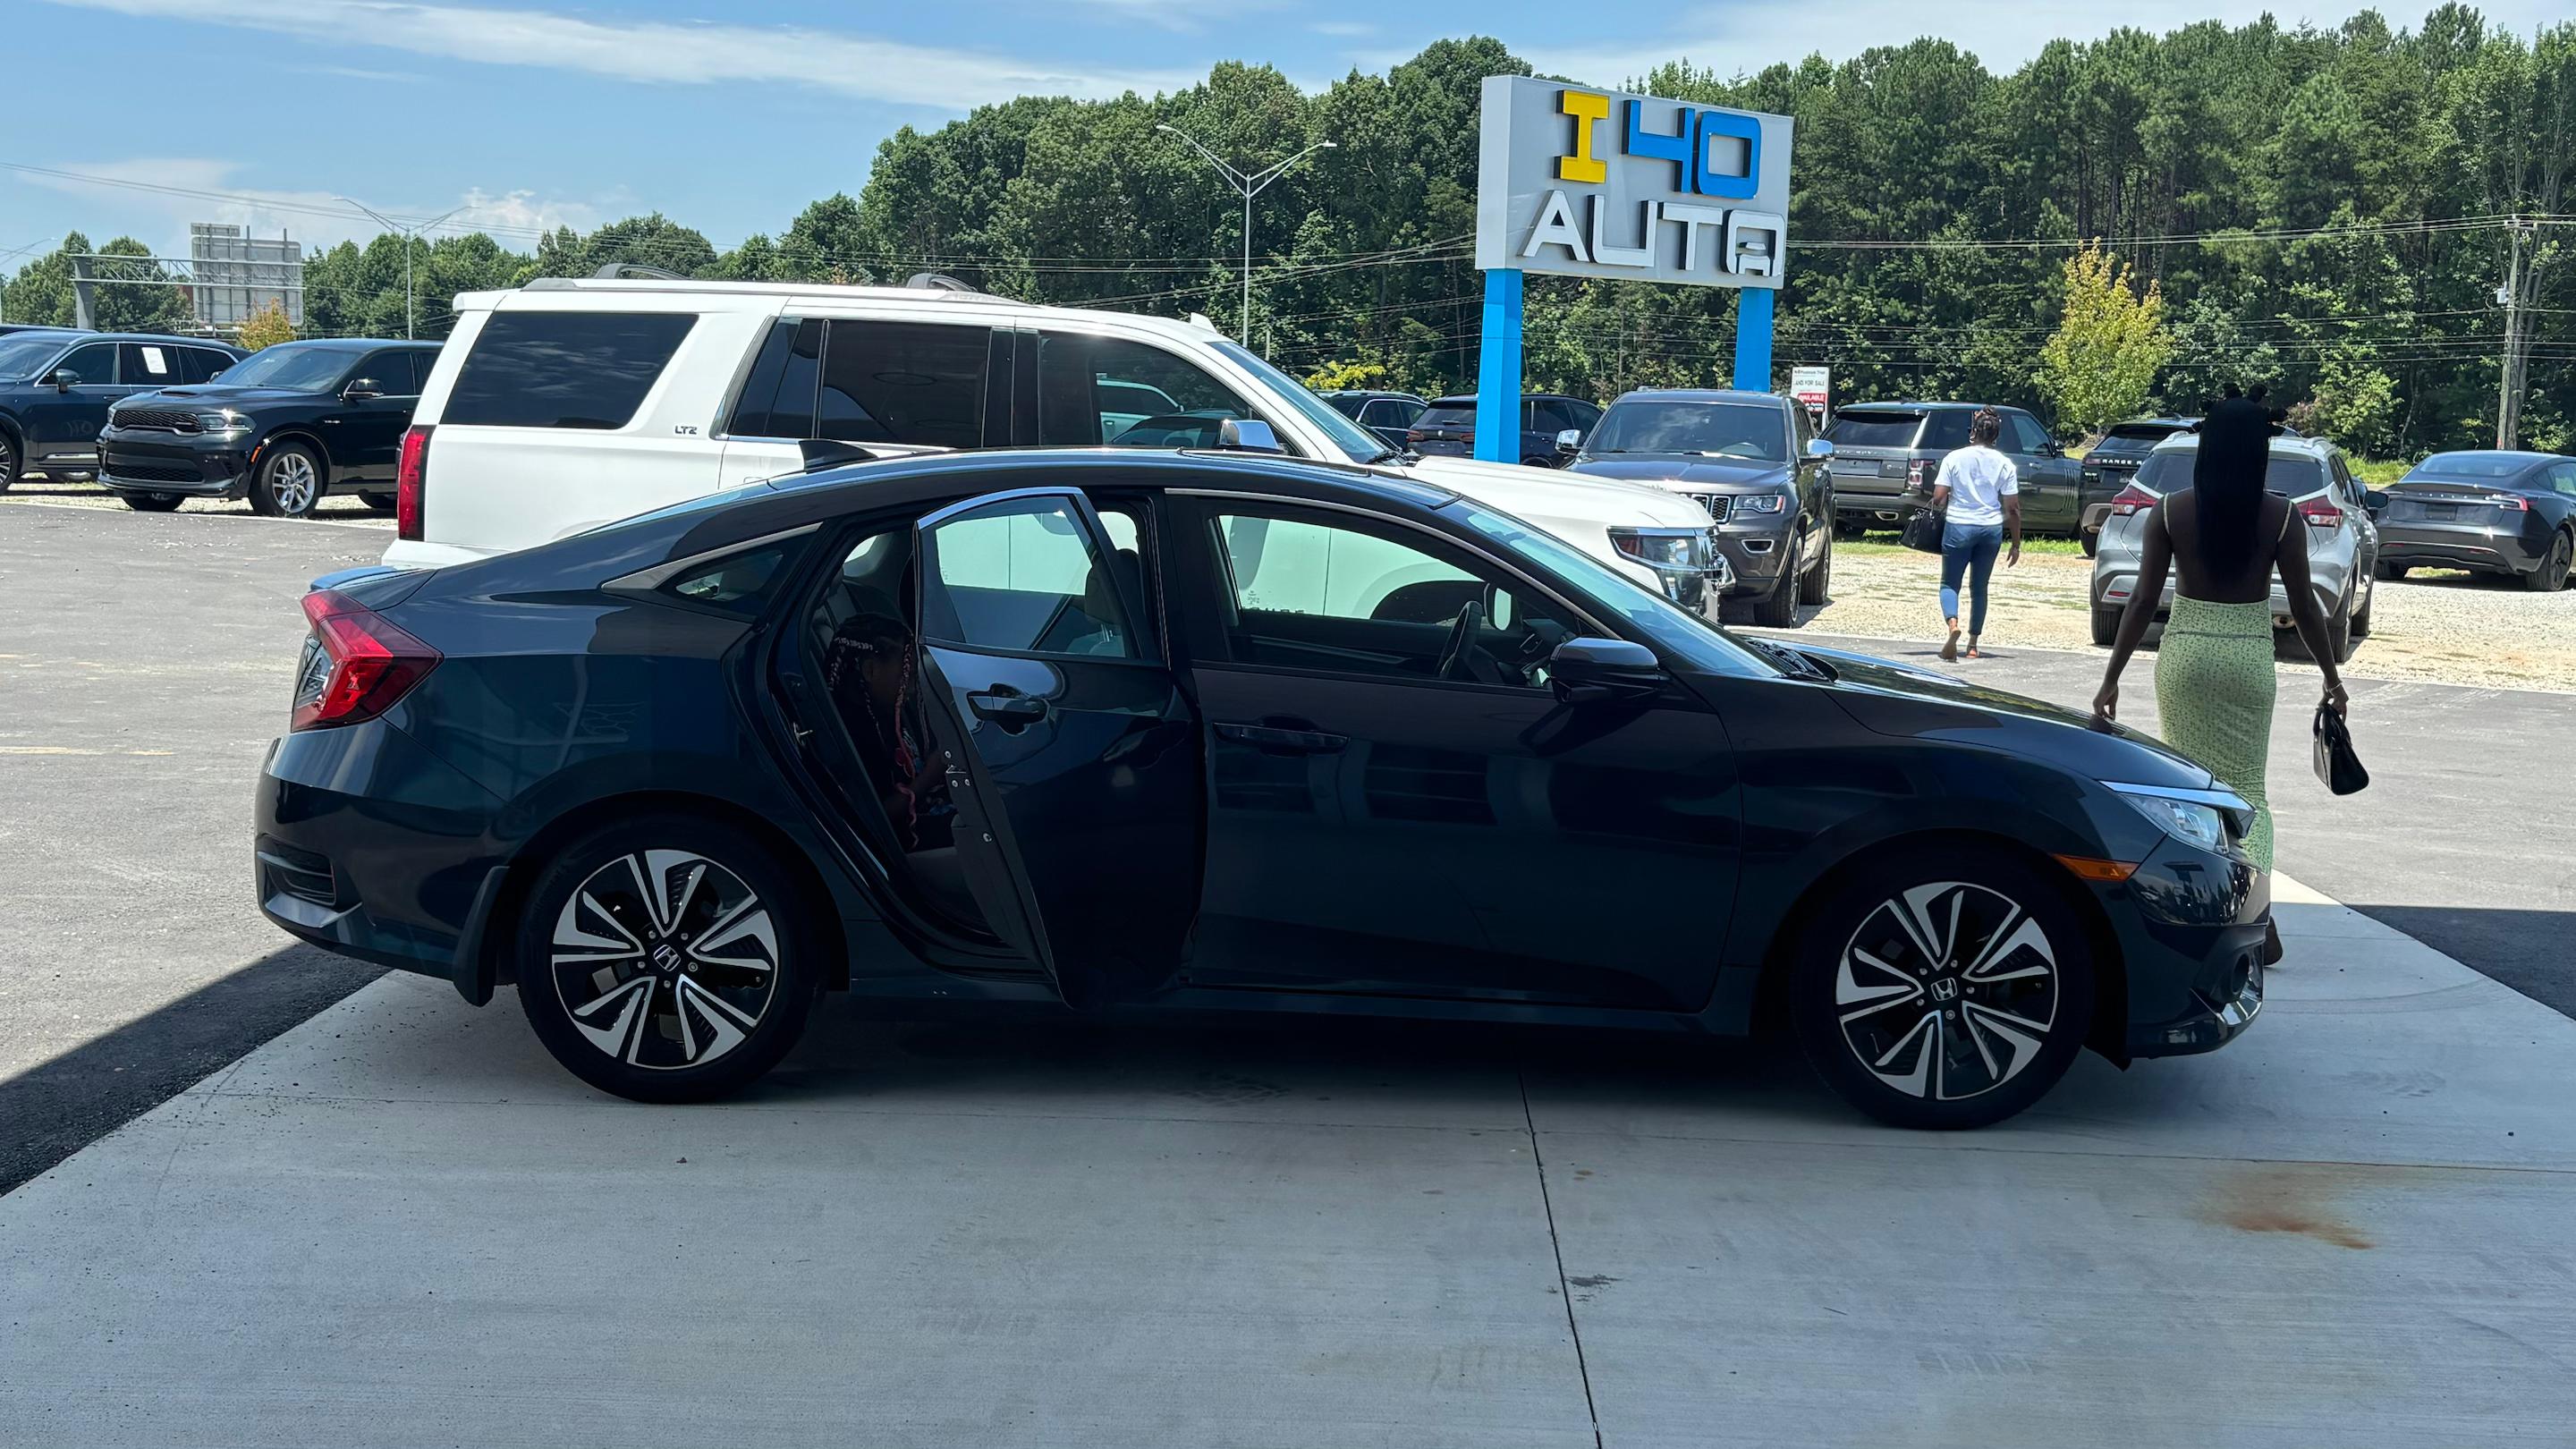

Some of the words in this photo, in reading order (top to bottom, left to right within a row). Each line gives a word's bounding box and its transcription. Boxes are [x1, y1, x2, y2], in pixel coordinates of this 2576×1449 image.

[1555, 89, 1609, 183] I
[1622, 99, 1761, 199] 40
[1520, 190, 1786, 277] AUTO
[674, 425, 698, 435] LTZ
